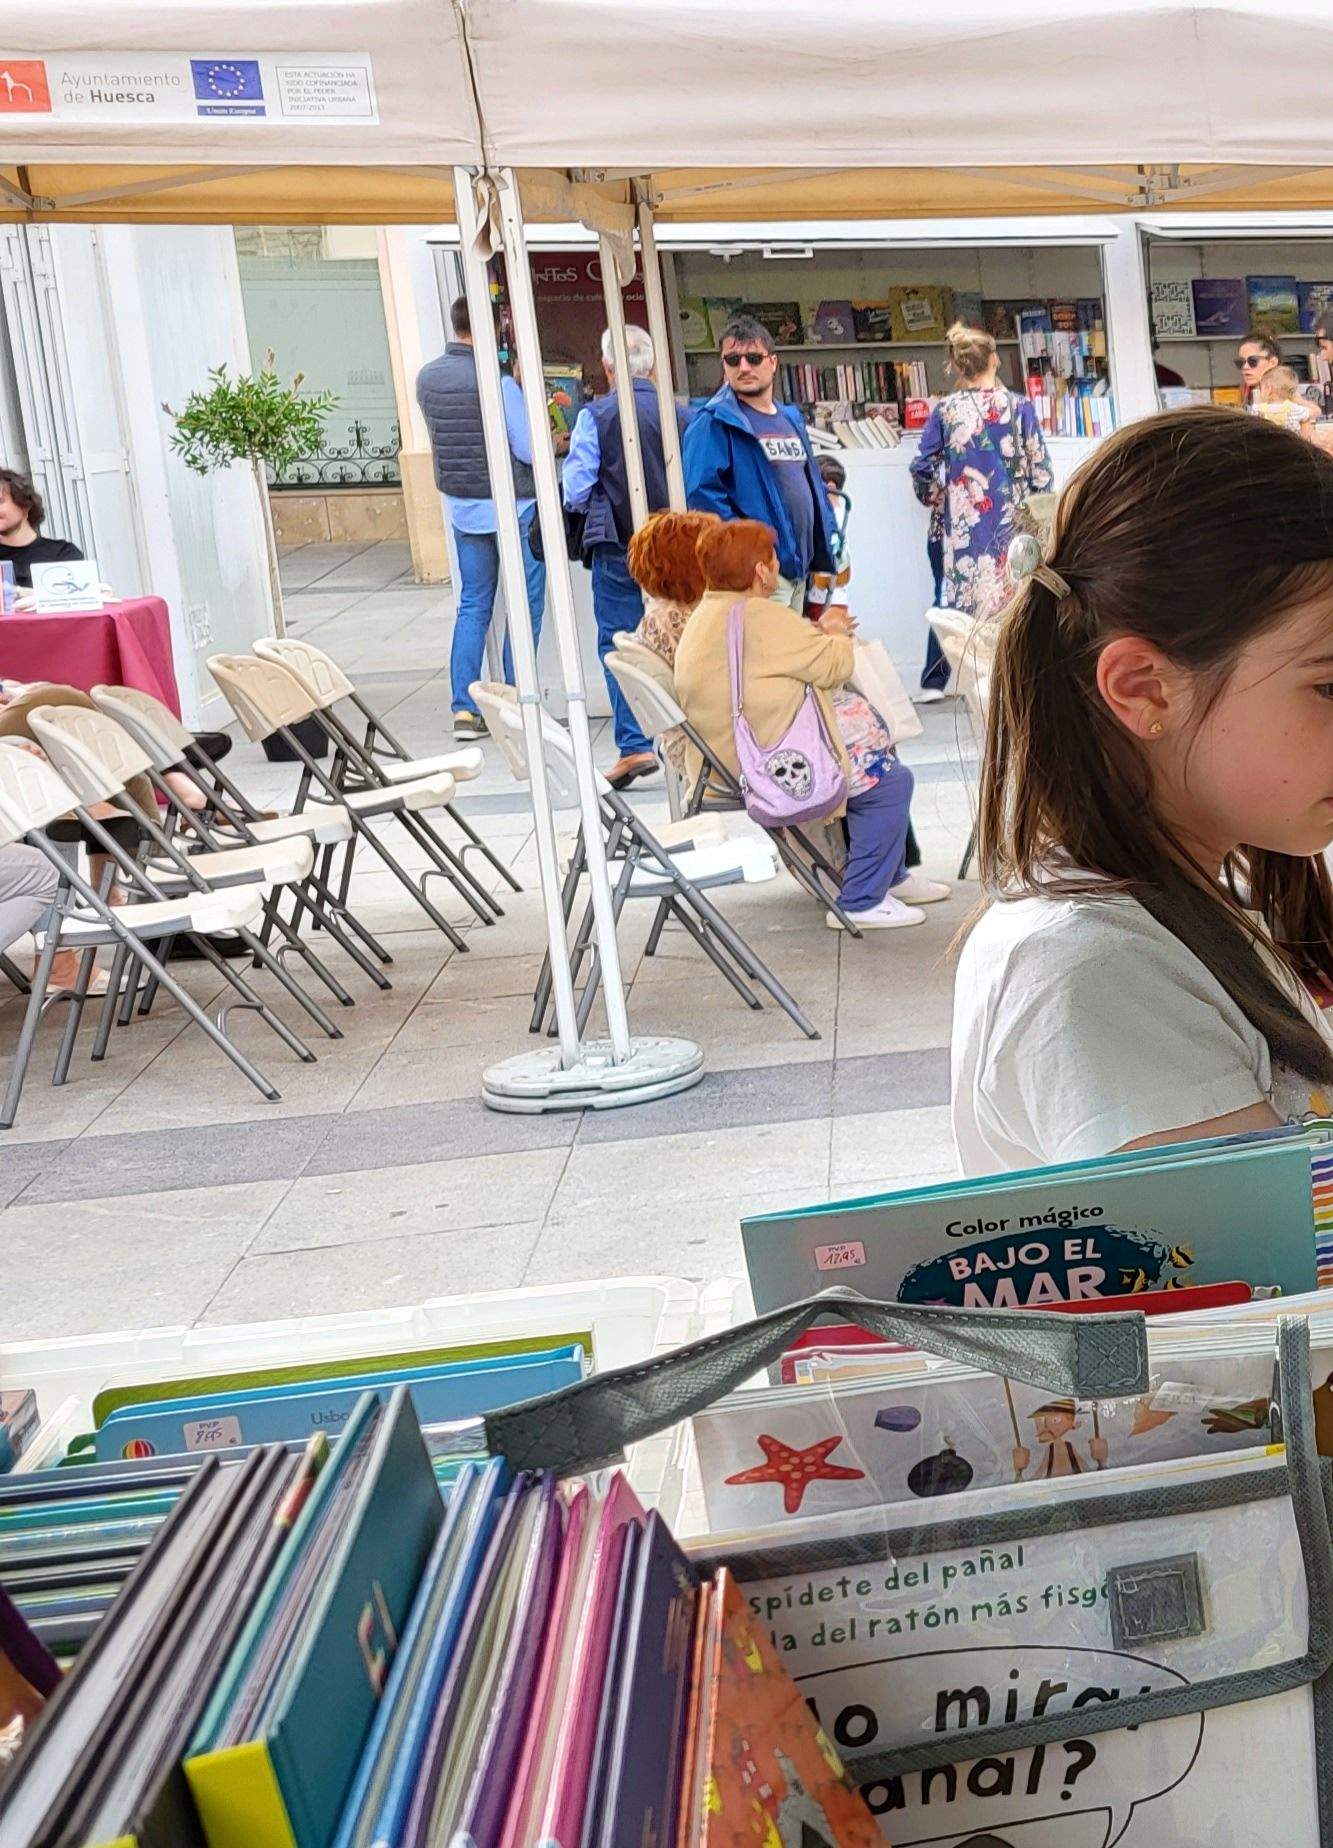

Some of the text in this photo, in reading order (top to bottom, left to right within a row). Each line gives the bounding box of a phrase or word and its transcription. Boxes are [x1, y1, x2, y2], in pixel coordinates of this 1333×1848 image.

[61, 72, 180, 92] Ayuntamiento
[65, 90, 155, 104] de Huesca
[945, 1206, 1104, 1238] Color mágico
[949, 1238, 1102, 1281] BAJO EL
[963, 1266, 1106, 1308] MAR
[884, 1561, 929, 1592] del
[942, 1544, 1026, 1589] pañal
[812, 1617, 857, 1648] del
[869, 1606, 959, 1638] ratón
[971, 1592, 1028, 1622] más
